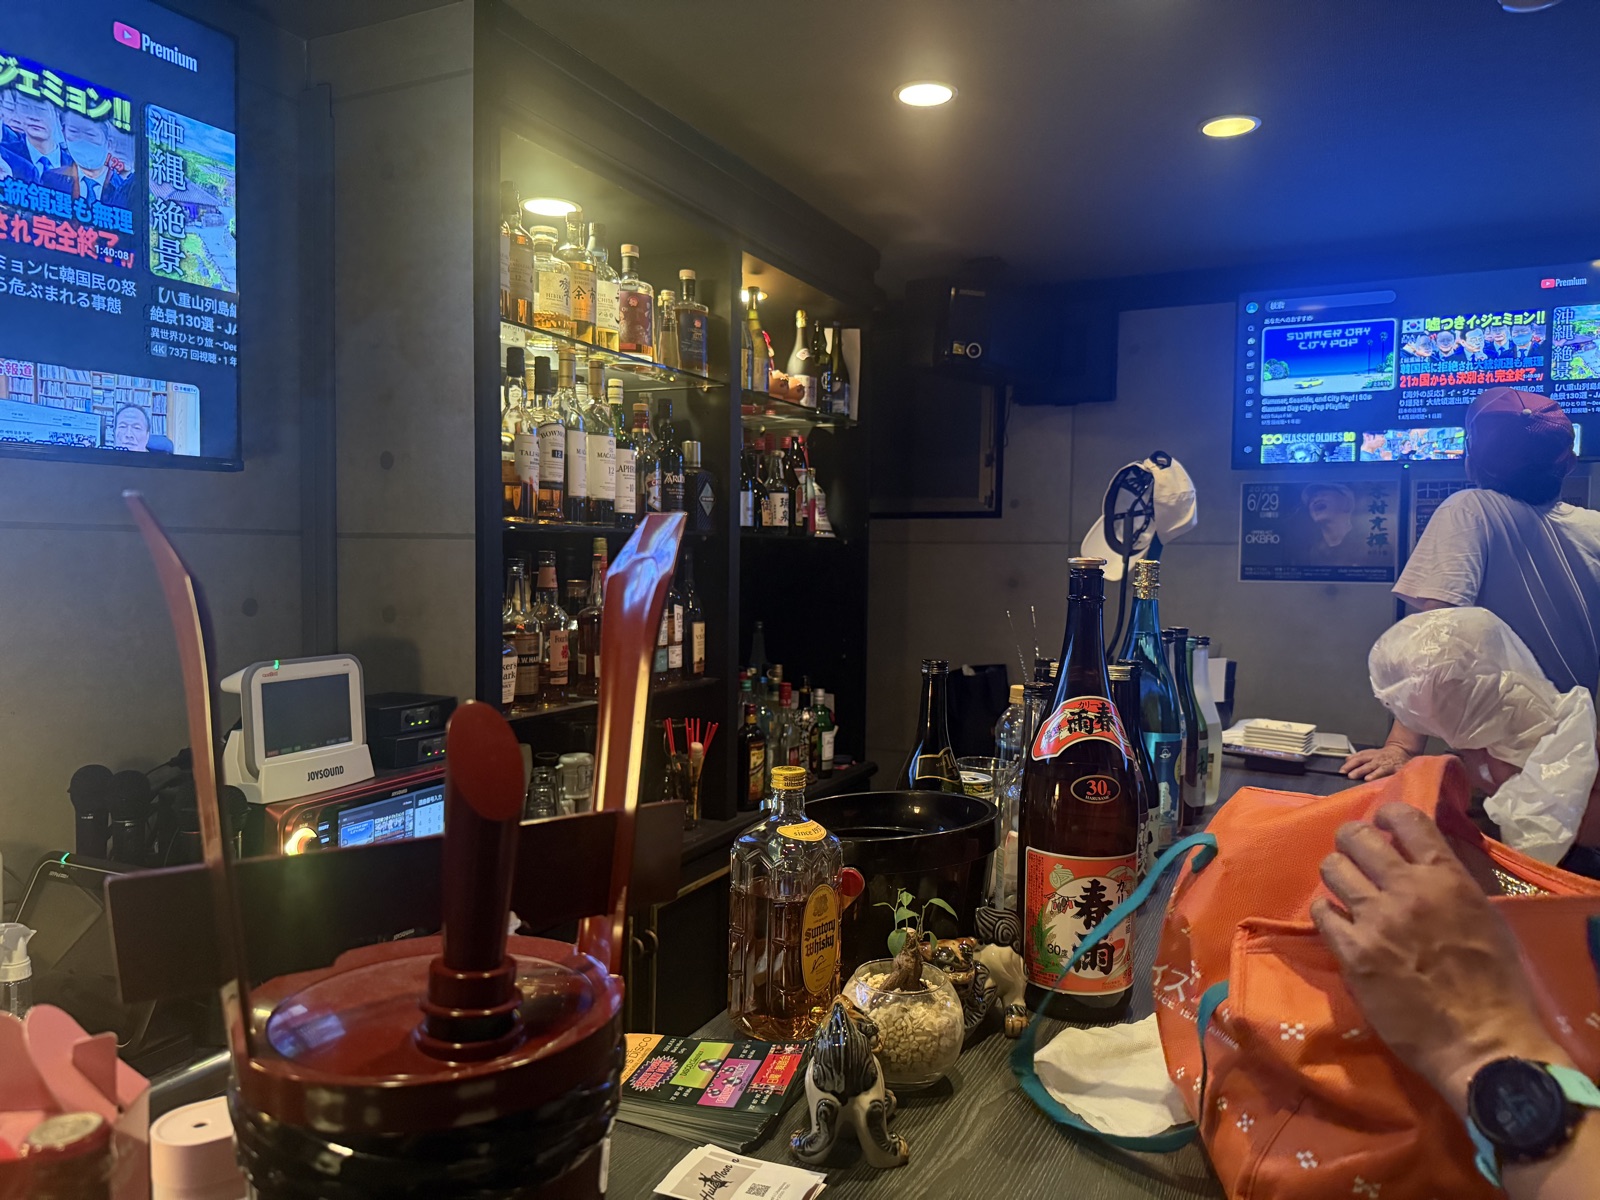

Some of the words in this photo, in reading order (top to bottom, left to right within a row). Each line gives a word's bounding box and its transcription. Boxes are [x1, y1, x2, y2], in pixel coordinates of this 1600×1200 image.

[141, 33, 198, 73] Premium
[0, 177, 134, 235] 統領選も無理
[94, 245, 129, 260] 1:40:08
[1555, 276, 1587, 287] Premium
[150, 305, 214, 333] 絶景130選
[150, 327, 214, 348] 異世界ひとり旅
[1287, 329, 1342, 341] SUMMER
[1345, 327, 1371, 337] DAY
[152, 344, 165, 354] 4K
[169, 346, 188, 359] 73万
[1298, 341, 1328, 350] CITY
[1330, 338, 1358, 348] POP
[1261, 433, 1283, 445] 100
[1282, 433, 1315, 444] CLASSIC
[1315, 432, 1344, 443] OLDIES
[608, 467, 615, 475] 12
[1246, 492, 1279, 512] 6/29
[307, 765, 344, 781] JOYSOUND
[804, 919, 836, 941] Suntory
[805, 934, 834, 957] Whisky
[1047, 943, 1069, 957] 30度
[629, 1036, 652, 1059] DISCO
[711, 1164, 733, 1179] Moon
